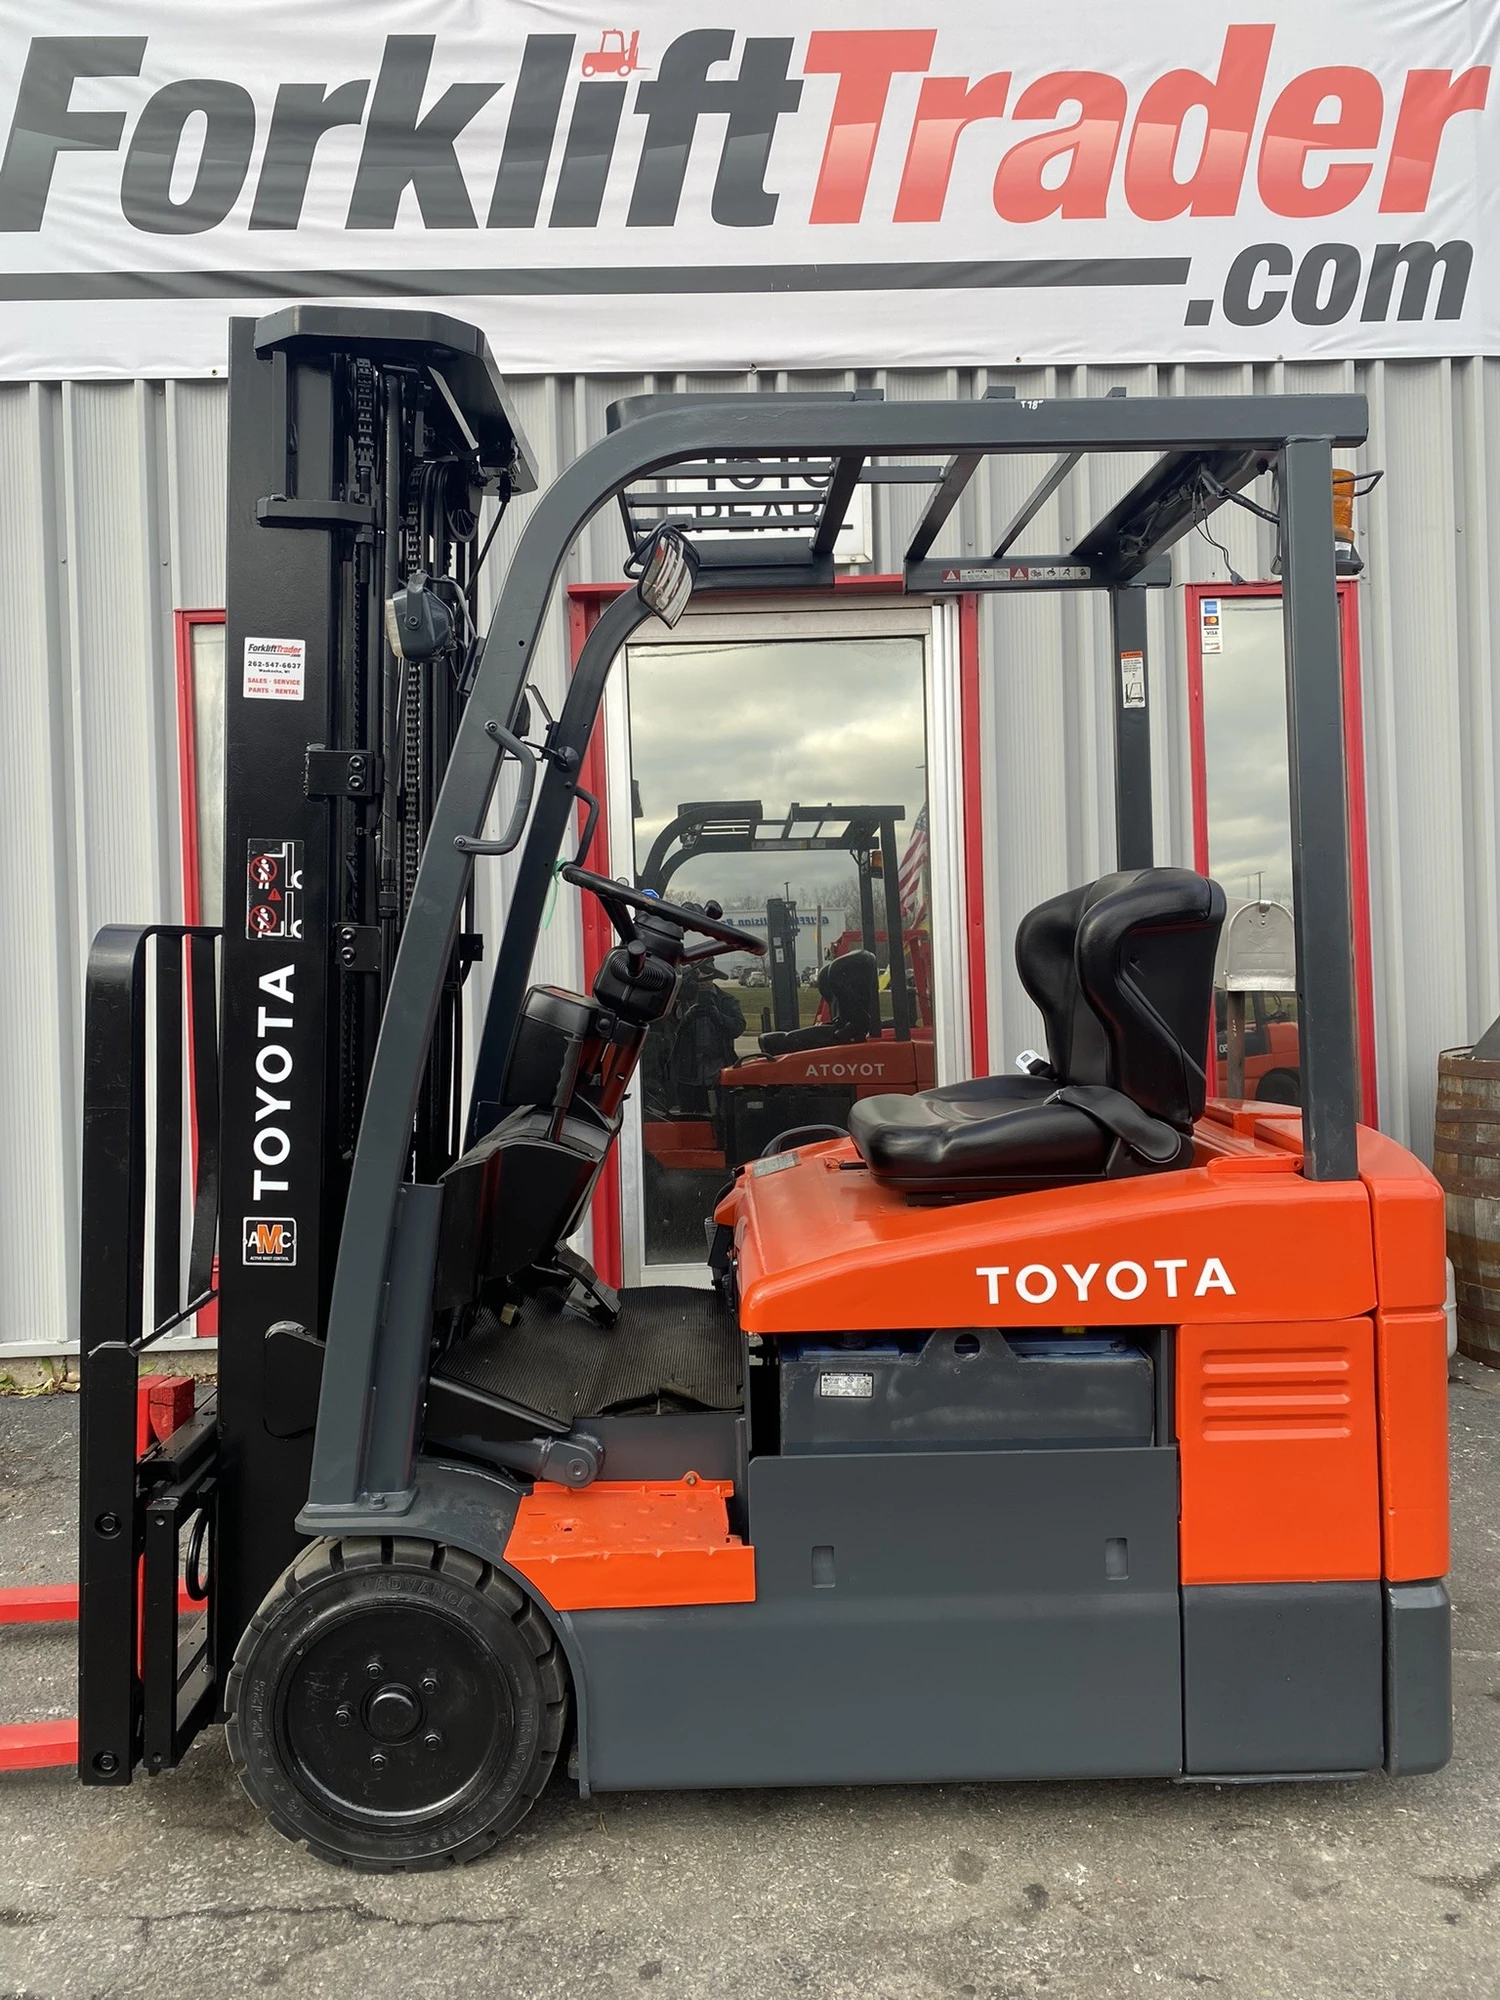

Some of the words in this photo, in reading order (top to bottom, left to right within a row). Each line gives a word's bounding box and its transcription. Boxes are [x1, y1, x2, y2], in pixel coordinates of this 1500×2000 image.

[0, 24, 1491, 236] ForkliftTrader
[1184, 240, 1473, 327] .com
[248, 643, 302, 653] ForkliftTrader
[248, 660, 301, 669] 262-547-6637
[273, 678, 301, 686] SERVICE
[252, 963, 295, 1201] TOYOTA
[247, 1224, 292, 1254] AMC
[975, 1257, 1237, 1305] TOYOTA
